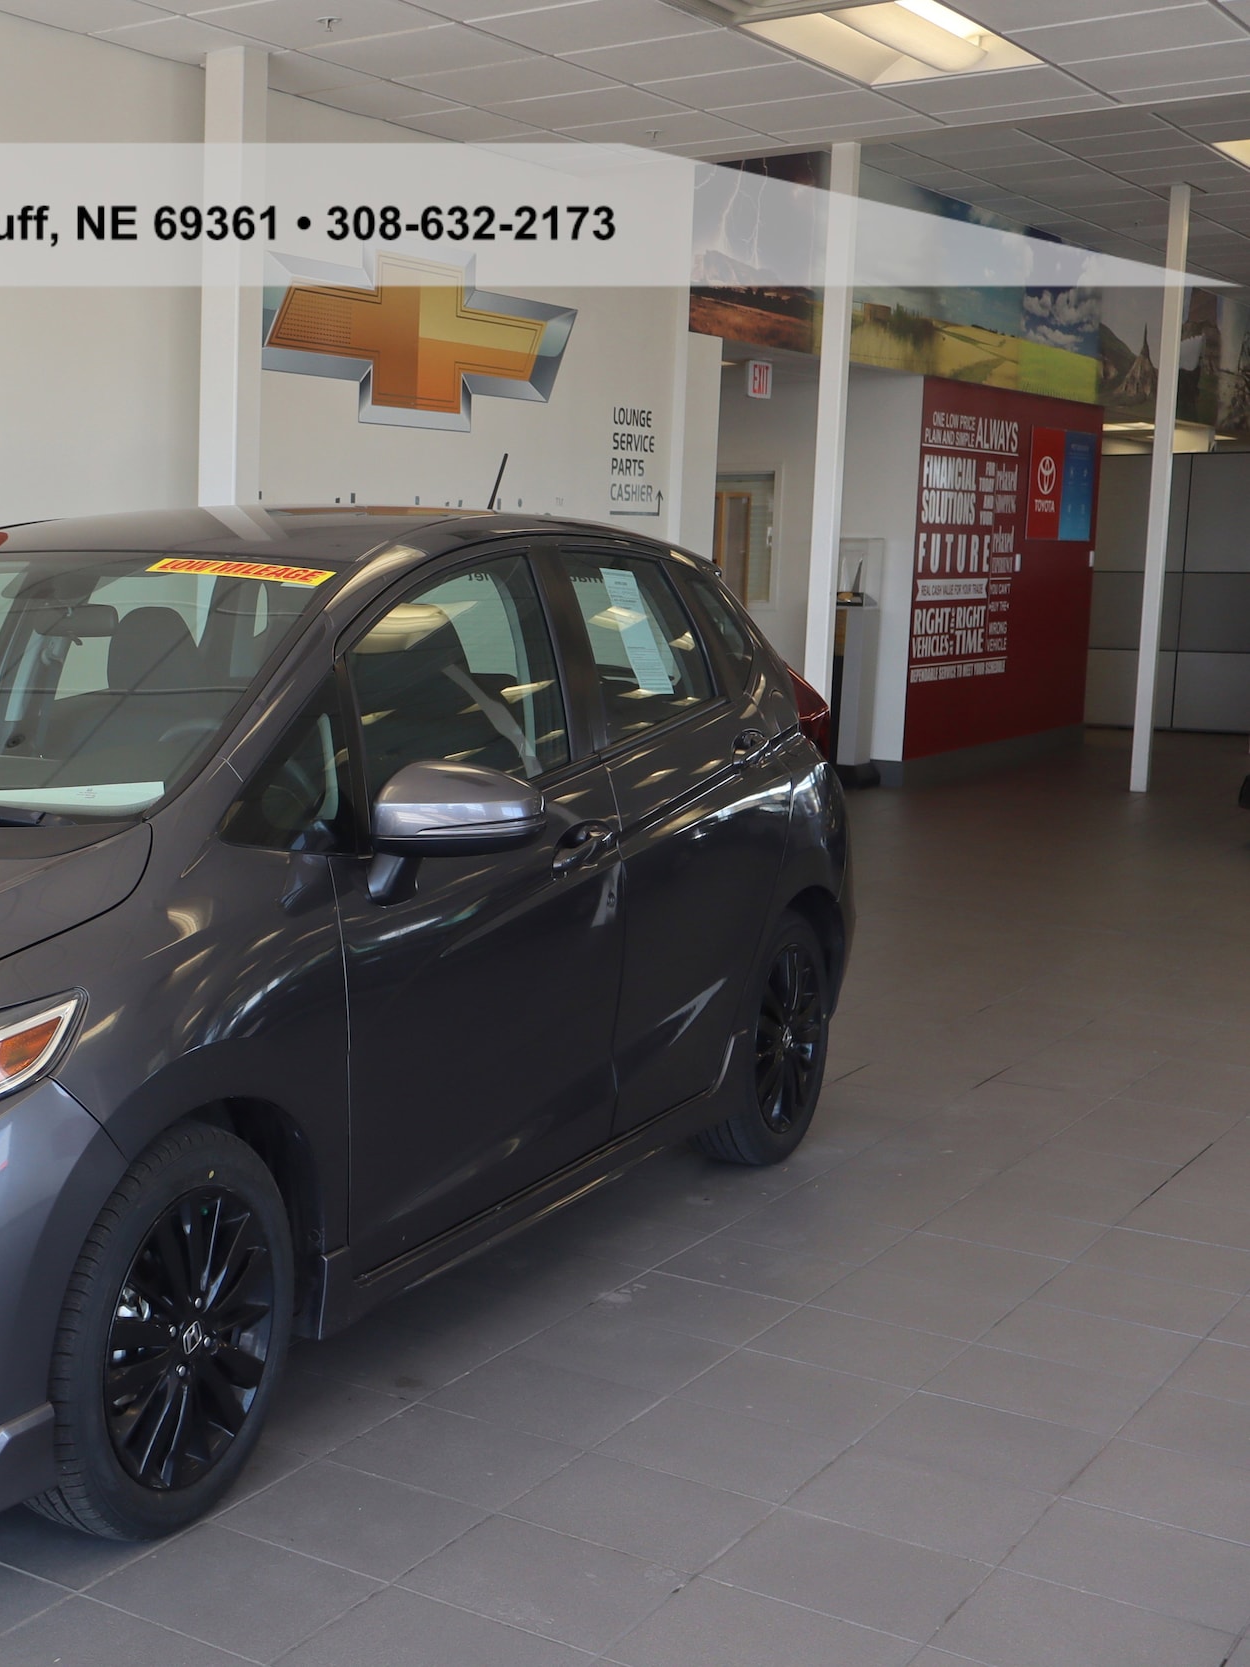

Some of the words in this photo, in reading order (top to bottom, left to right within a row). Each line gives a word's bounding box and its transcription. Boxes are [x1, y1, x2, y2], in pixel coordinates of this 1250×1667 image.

[752, 364, 769, 394] EXIT
[613, 406, 652, 428] LOUNGE
[933, 411, 945, 428] ONE
[946, 413, 959, 429] LOW
[959, 415, 976, 432] PRICE
[612, 432, 655, 453] SERVICE
[924, 427, 942, 444] PLAIN
[942, 430, 955, 446] AND
[955, 431, 976, 448] SIMPLE
[975, 417, 1019, 453] ALWAYS
[611, 457, 645, 477] PARTS
[922, 454, 977, 492] FINANCIAL
[610, 483, 653, 502] CASHIER
[921, 488, 977, 526] SOLUTIONS
[1034, 499, 1056, 513] TOYOTA
[918, 533, 991, 573] FUTURE
[158, 559, 211, 572] LOW
[210, 562, 325, 583] MILEAGE
[913, 608, 951, 635] RIGHT
[956, 606, 986, 629] RIGHT
[912, 635, 949, 658] VEHICLES
[955, 629, 985, 655] TIME
